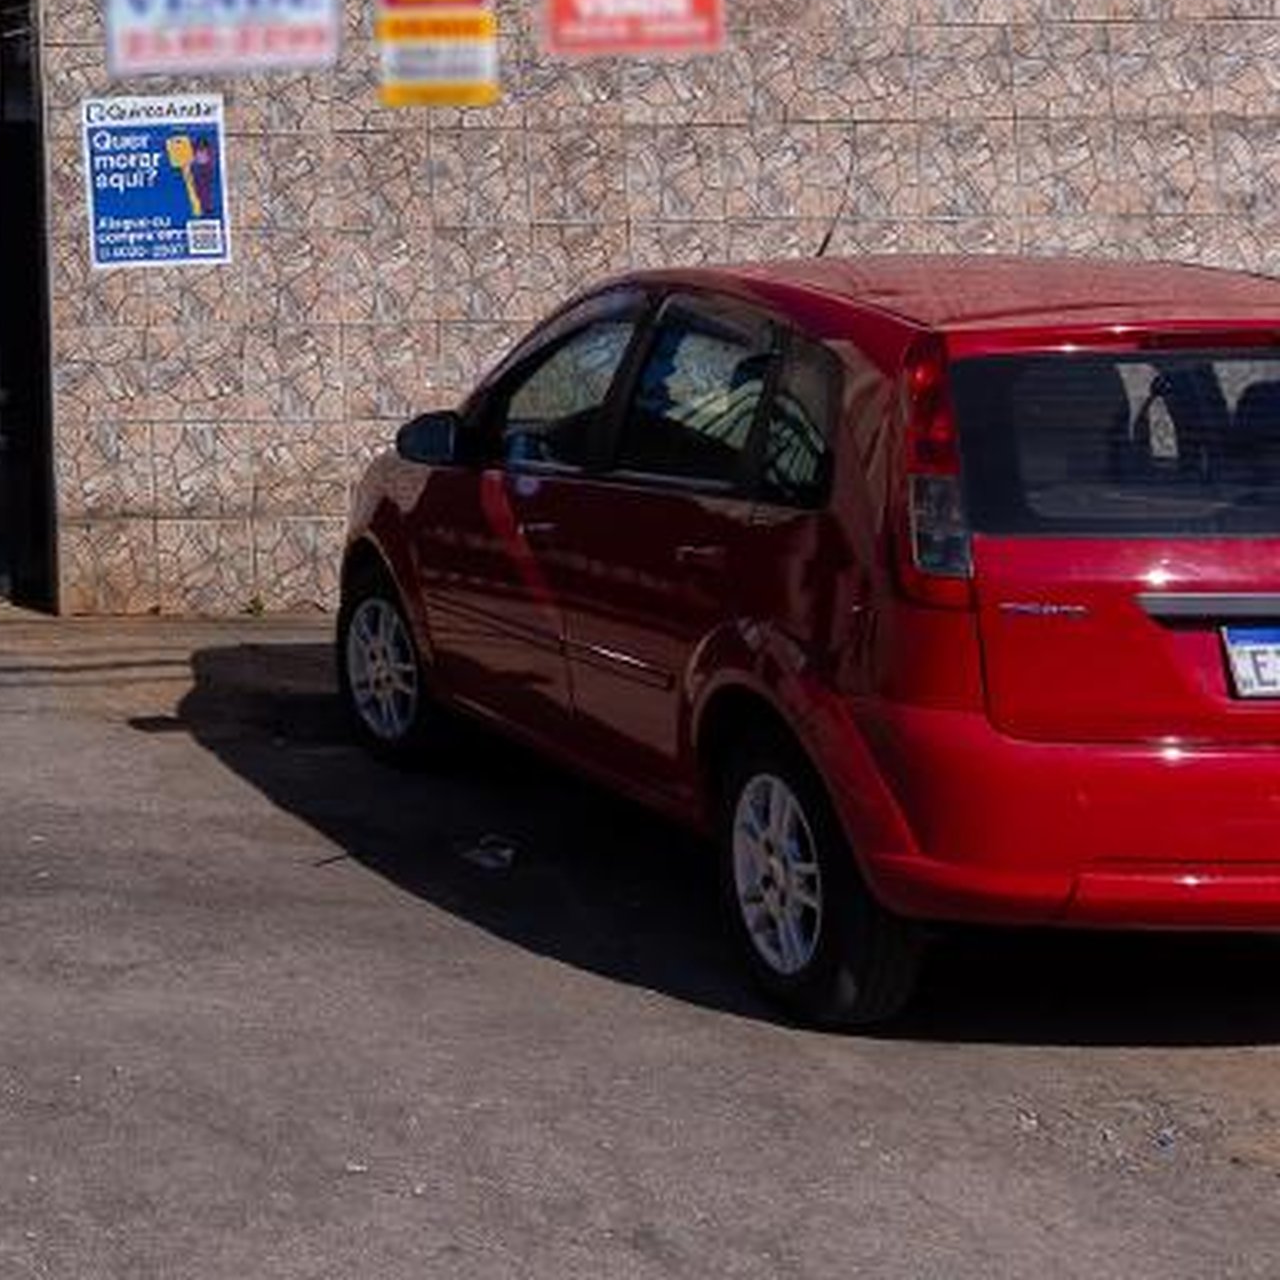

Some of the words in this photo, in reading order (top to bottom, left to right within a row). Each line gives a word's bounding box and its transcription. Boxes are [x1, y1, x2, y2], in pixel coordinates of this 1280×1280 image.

[93, 130, 150, 151] Quer
[93, 153, 161, 170] morar
[95, 169, 158, 192] aqui?
